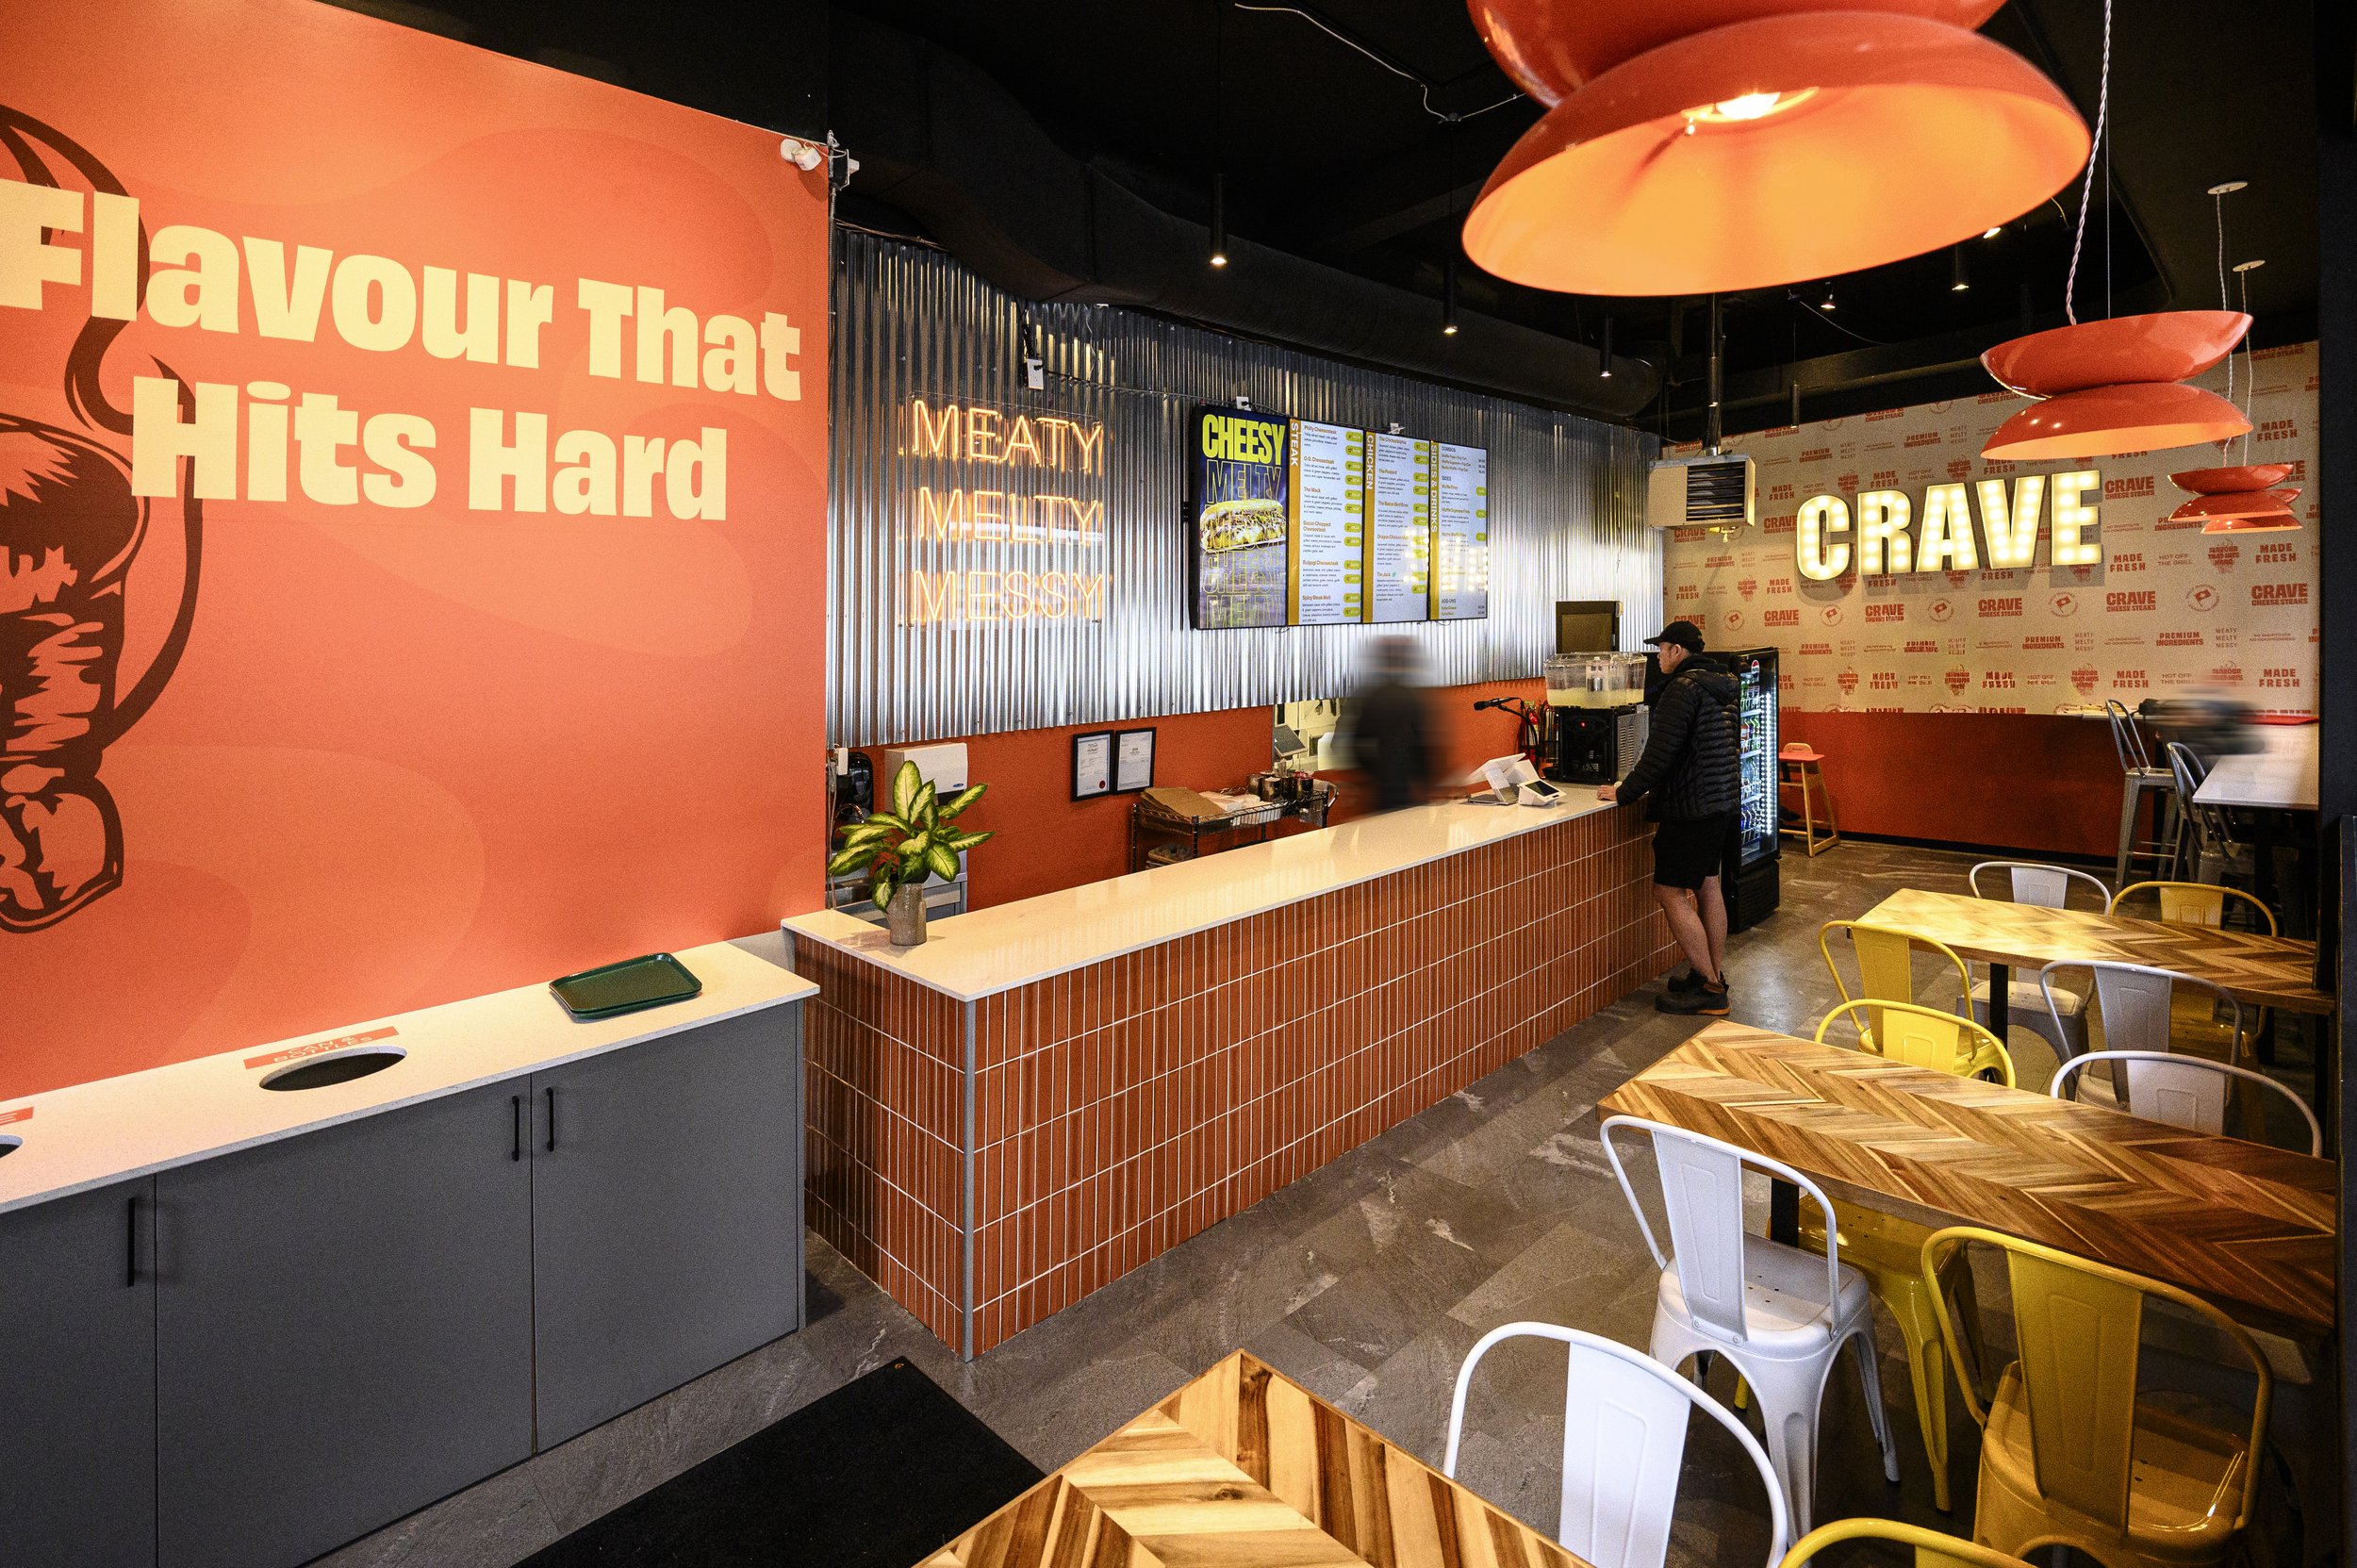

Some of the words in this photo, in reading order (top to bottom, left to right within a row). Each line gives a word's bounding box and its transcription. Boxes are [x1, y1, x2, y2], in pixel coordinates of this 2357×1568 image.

[0, 178, 553, 369] Flavour
[578, 276, 801, 402] That
[2261, 420, 2294, 432] MADE
[913, 400, 1102, 470] MEATY
[1202, 414, 1286, 466] CHEESY
[1906, 432, 1938, 441] PREMIUM
[2257, 429, 2298, 442] FRESH
[132, 375, 437, 508] Hits
[469, 406, 728, 521] Hard
[1291, 422, 1299, 467] STEAK
[1802, 448, 1830, 456] PREMIUM
[1873, 470, 1896, 480] MADE
[1984, 464, 2015, 475] FRESH
[1207, 459, 1281, 503] MELTY
[1871, 479, 1899, 488] FRESH
[2104, 475, 2154, 493] CRAVE
[1772, 485, 1792, 493] MADE
[1770, 491, 1794, 501] FRESH
[2105, 491, 2130, 501] CHEESE
[2130, 489, 2155, 498] STEAKS
[920, 487, 1099, 544] MELTY
[1764, 515, 1797, 529] CRAVE
[1797, 470, 2102, 580] CRAVE
[1674, 528, 1706, 538] CRAVE
[2260, 543, 2293, 553] MADE
[2114, 553, 2143, 563] MADE
[2255, 553, 2297, 564] FRESH
[2110, 562, 2146, 572] FRESH
[1982, 570, 2014, 581] FRESH
[1869, 579, 1897, 587] FRESH
[913, 570, 1103, 620] MESSY
[1767, 586, 1792, 594] FRESH
[2251, 583, 2308, 600] CRAVE
[1676, 592, 1699, 601] FRESH
[2106, 591, 2156, 605] CRAVE
[1865, 603, 1904, 617] CRAVE
[1978, 598, 2022, 611] CRAVE
[1764, 609, 1799, 621] CRAVE
[2156, 638, 2204, 647] INGREDIENTS
[2117, 670, 2146, 679] MADE
[2264, 668, 2297, 677] MADE
[2113, 680, 2149, 688] FRESH
[2259, 679, 2300, 687] FRESH
[273, 1036, 374, 1063] BOTTLES
[287, 1040, 334, 1055] CAN
